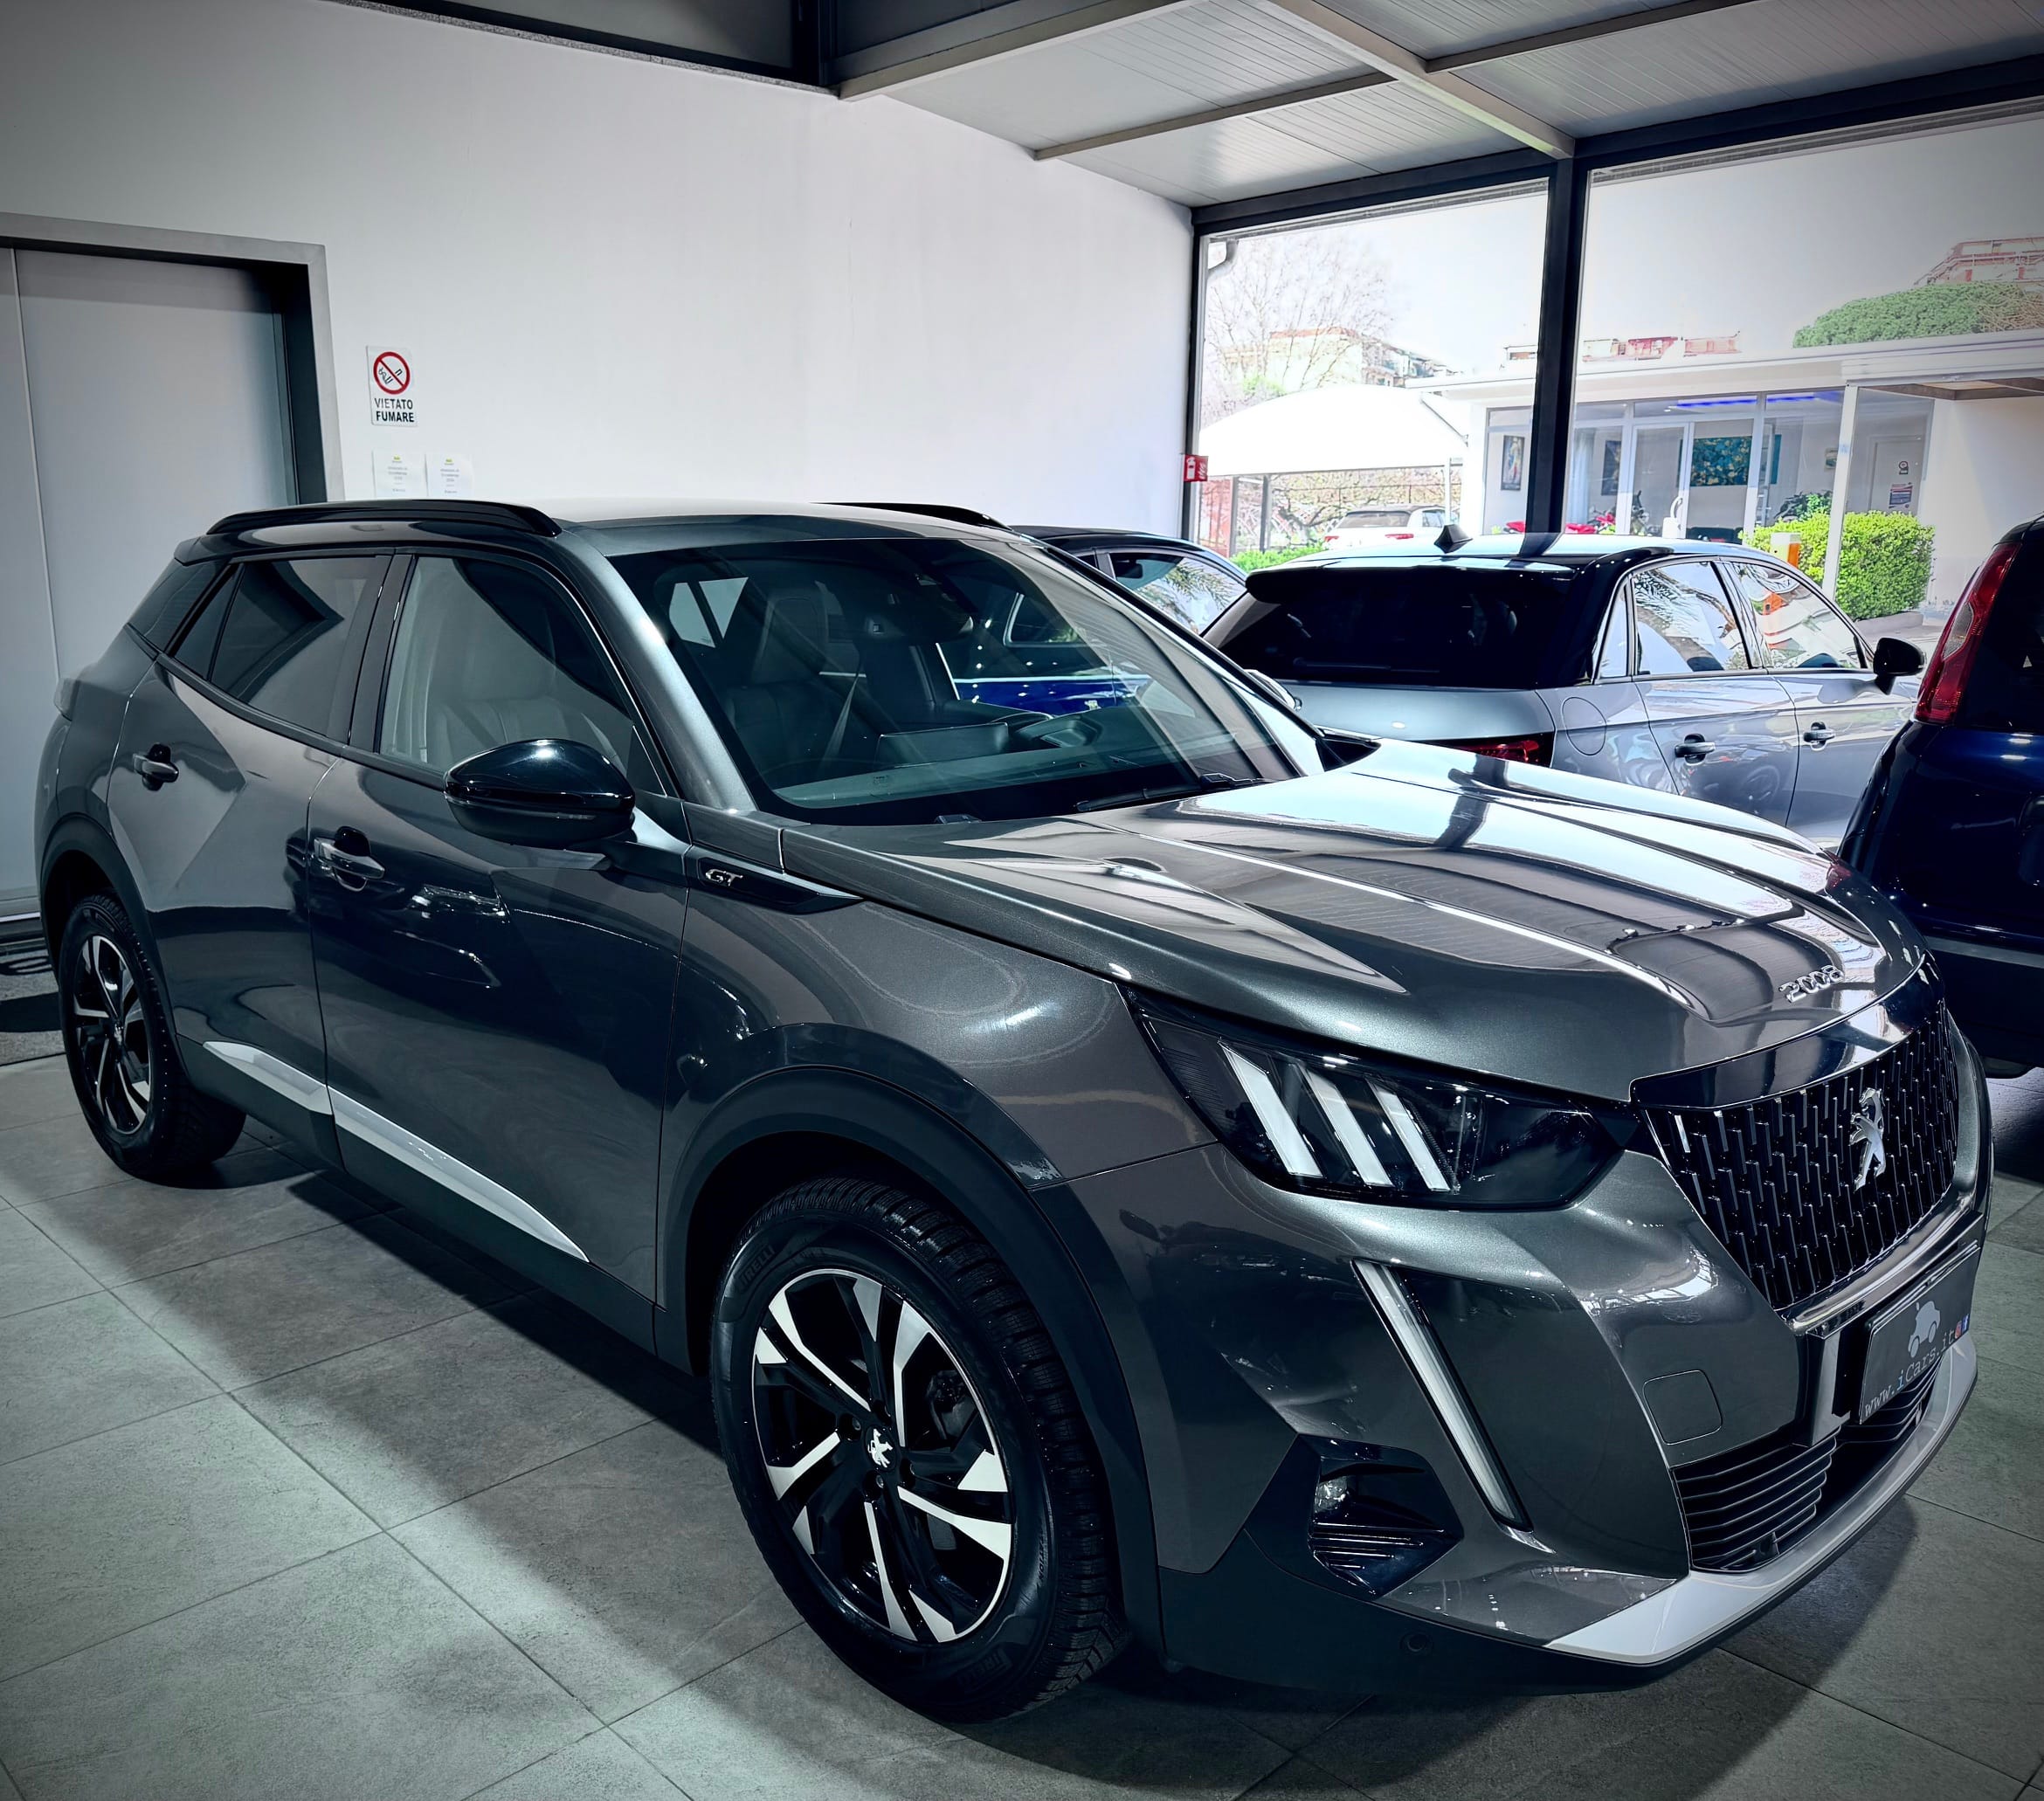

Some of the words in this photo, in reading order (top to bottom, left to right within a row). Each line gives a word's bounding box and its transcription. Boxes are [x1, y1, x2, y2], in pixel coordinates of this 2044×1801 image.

[374, 397, 413, 410] VIETATO
[376, 411, 415, 423] FUMARE
[705, 868, 743, 887] GT
[1778, 964, 1845, 1003] 2008
[1864, 1328, 1955, 1418] www.iCars.it
